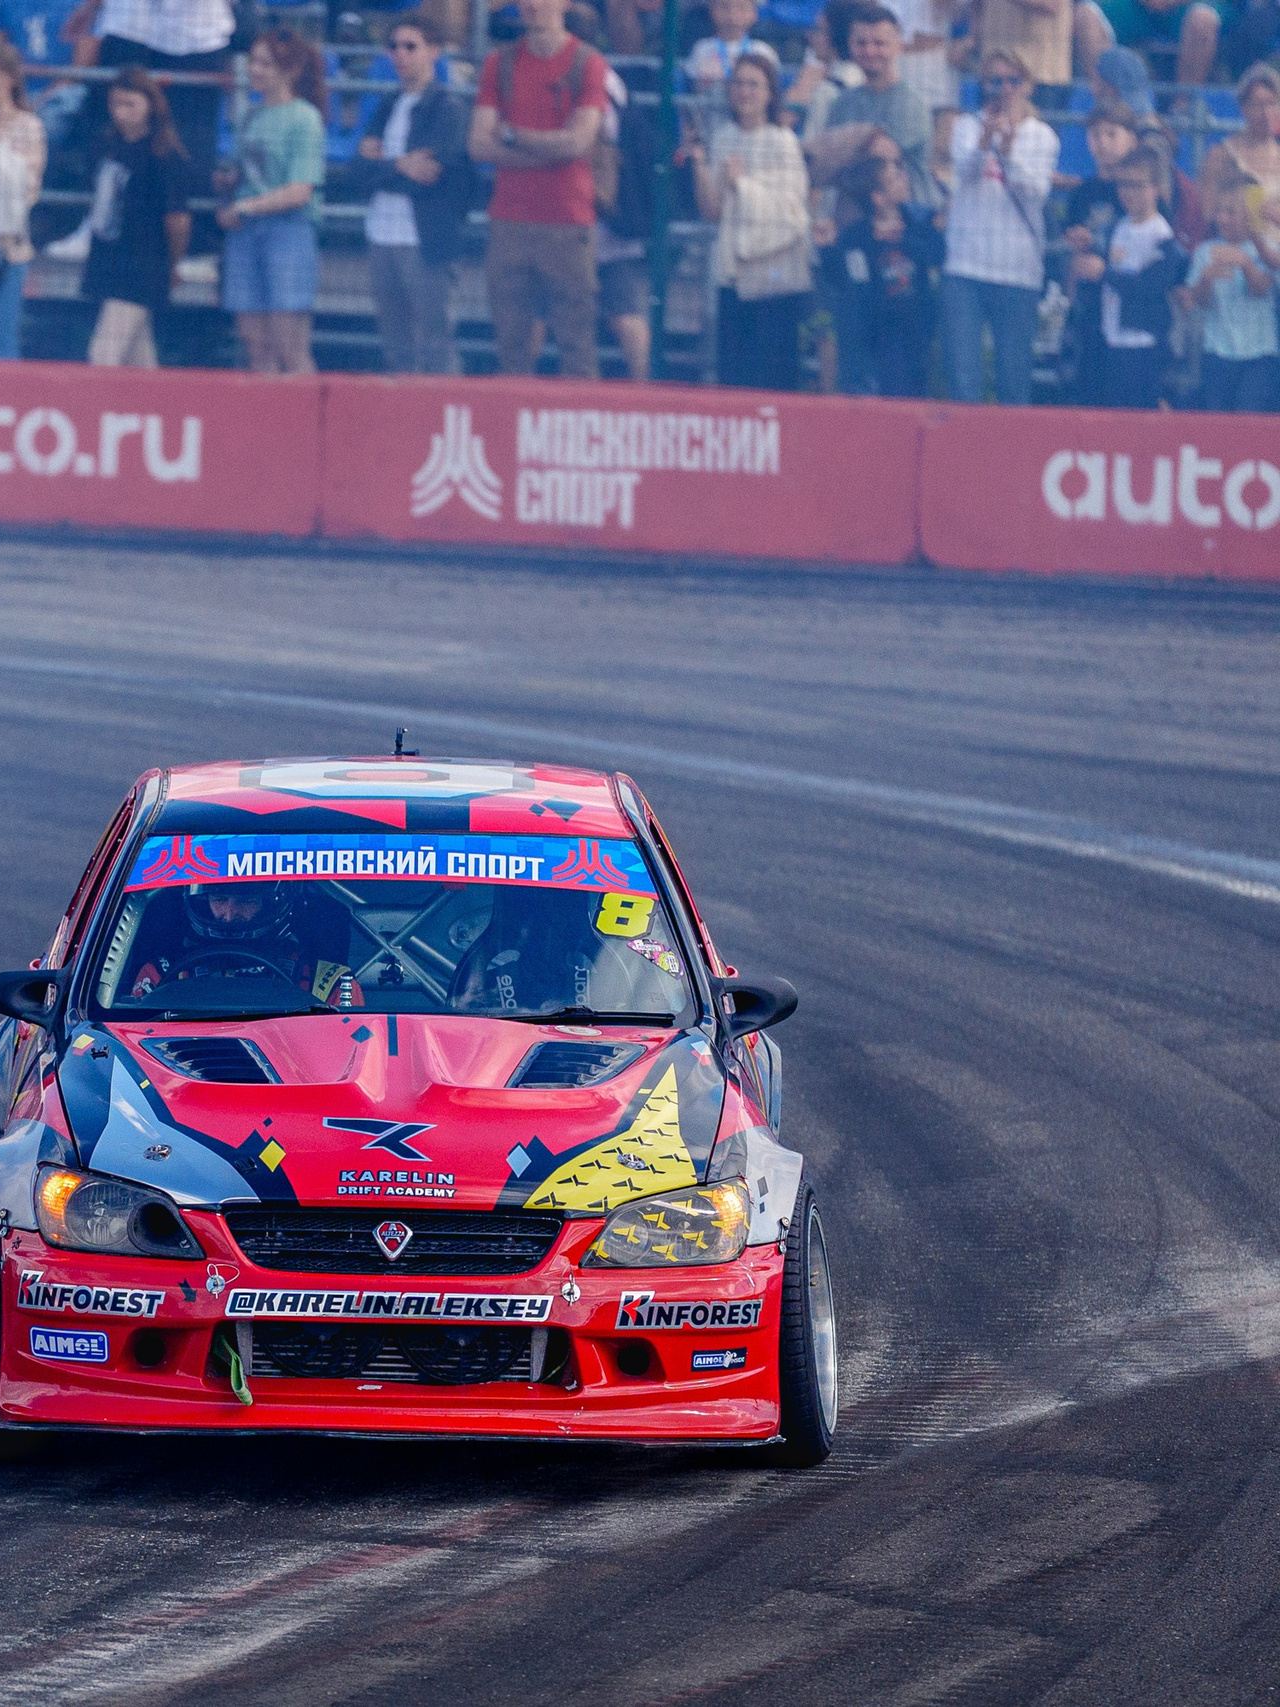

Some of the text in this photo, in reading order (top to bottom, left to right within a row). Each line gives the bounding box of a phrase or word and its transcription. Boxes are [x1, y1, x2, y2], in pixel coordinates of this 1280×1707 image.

[517, 405, 781, 475] МОСКОВСКИЙ
[516, 468, 642, 529] СПОРТ
[227, 846, 545, 881] МОСКОВСКИЙ СПОРТ
[596, 891, 656, 938] 8
[337, 1186, 457, 1199] DRIFT ACADEMY
[339, 1170, 456, 1186] KARELIN
[19, 1273, 163, 1315] KINFOREST
[227, 1291, 551, 1319] @KARELIN.ALEKSEY
[618, 1294, 763, 1327] KINFOREST
[34, 1333, 104, 1356] AIMOL
[695, 1356, 724, 1365] AIMOL
